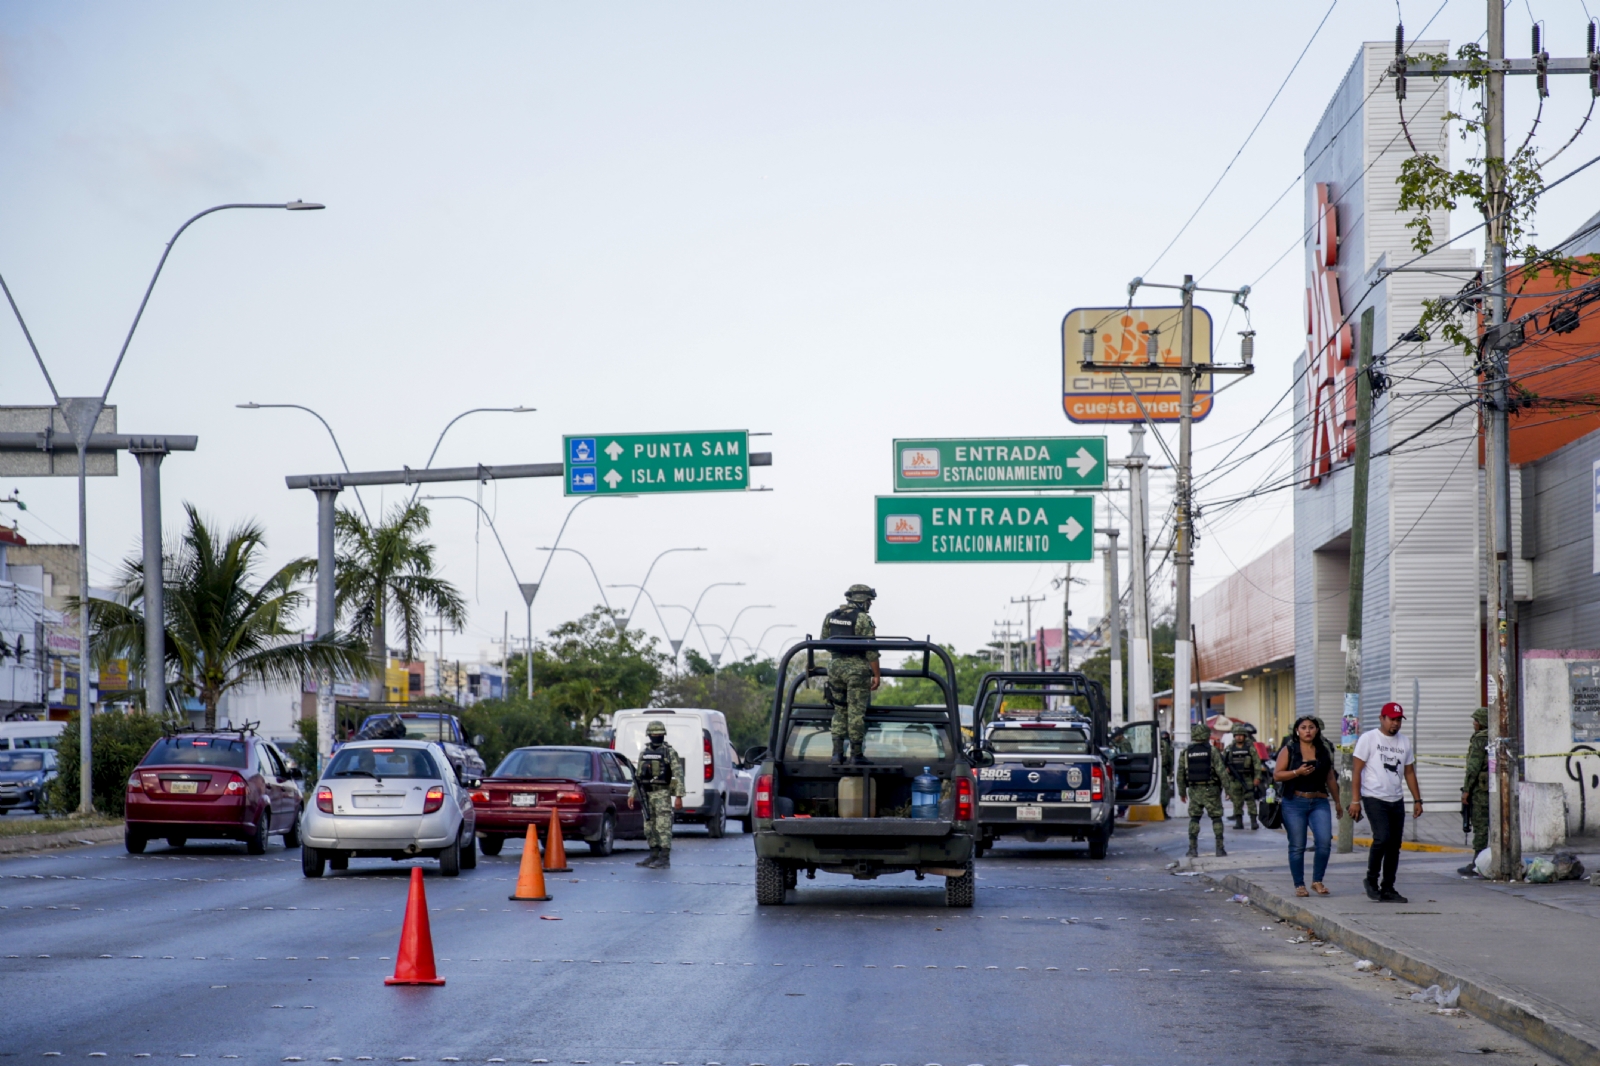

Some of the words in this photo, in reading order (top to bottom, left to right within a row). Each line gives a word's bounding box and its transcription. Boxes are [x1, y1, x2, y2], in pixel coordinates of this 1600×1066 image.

[1073, 376, 1203, 390] CHEDRAI
[1073, 399, 1137, 414] cuesta
[1144, 399, 1202, 413] mens
[634, 443, 693, 458] PUNTA
[701, 441, 739, 455] SAM
[955, 446, 1050, 461] ENTRADA
[631, 468, 666, 483] ISLA
[674, 466, 743, 481] MUJERES
[943, 465, 1062, 481] ESTACIONAMIENTO
[932, 507, 1049, 526] ENTRADA
[932, 534, 1049, 553] ESTACIONAMIENTO
[980, 768, 1011, 777] 5805
[981, 794, 1010, 802] SECTOR
[1010, 794, 1018, 802] 2
